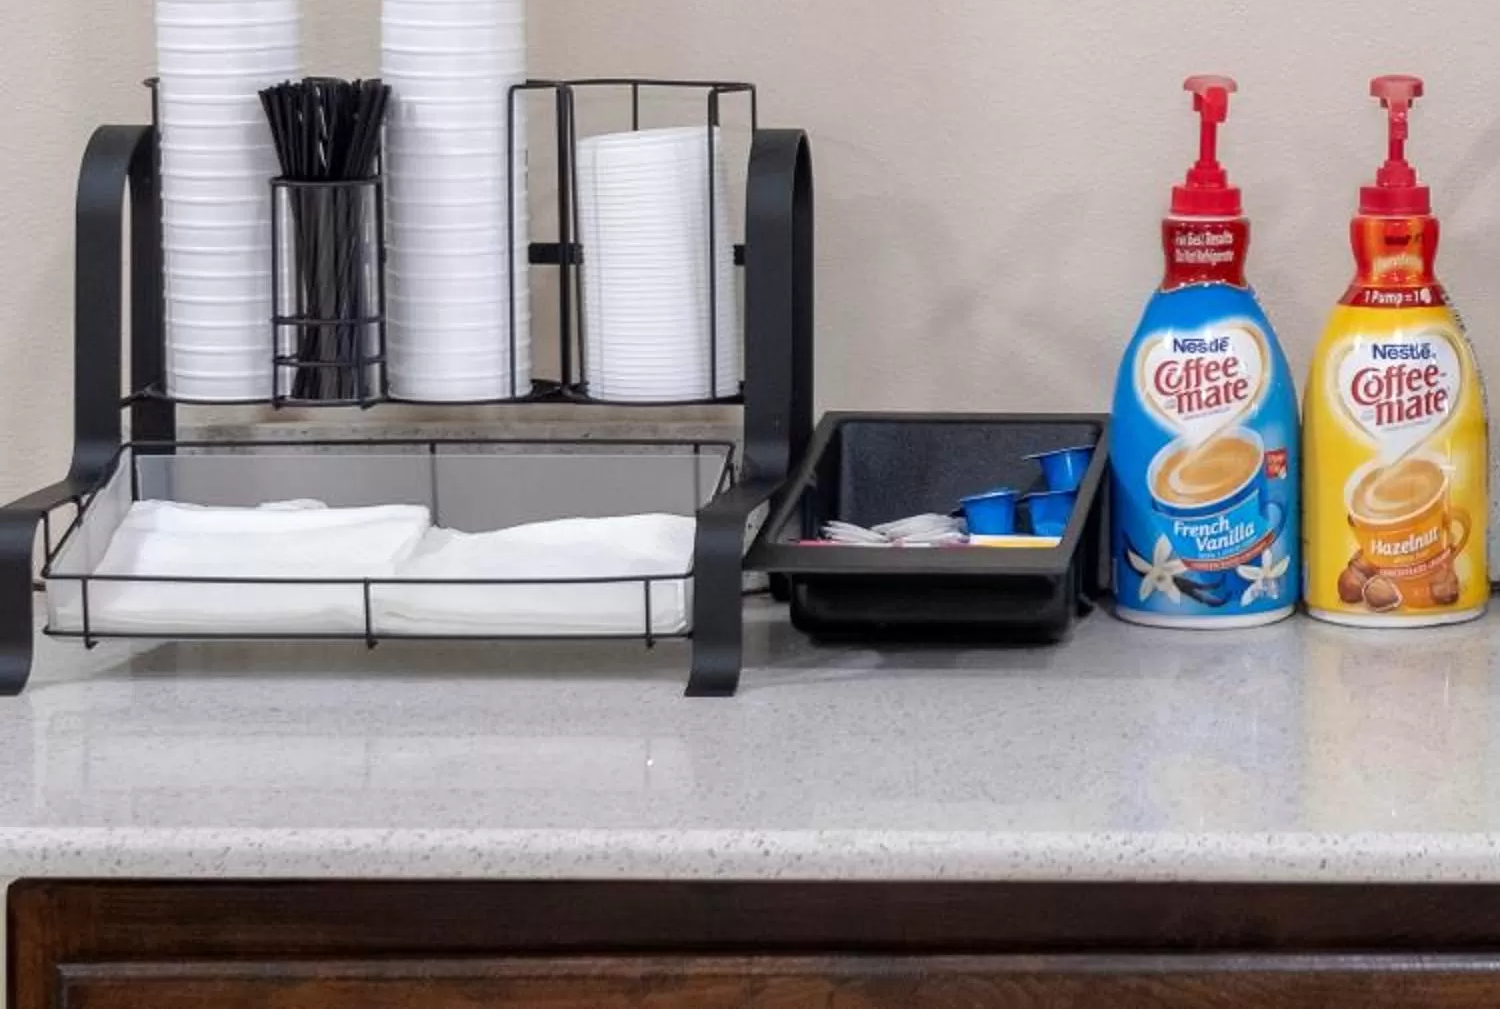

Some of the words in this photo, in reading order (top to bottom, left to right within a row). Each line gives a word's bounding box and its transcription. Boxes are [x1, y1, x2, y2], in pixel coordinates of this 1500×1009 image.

[1177, 378, 1248, 414] mate
[1375, 388, 1448, 425] mate
[1173, 516, 1230, 536] French
[1196, 522, 1255, 551] Vanilla
[1371, 526, 1439, 556] Hazelnut
